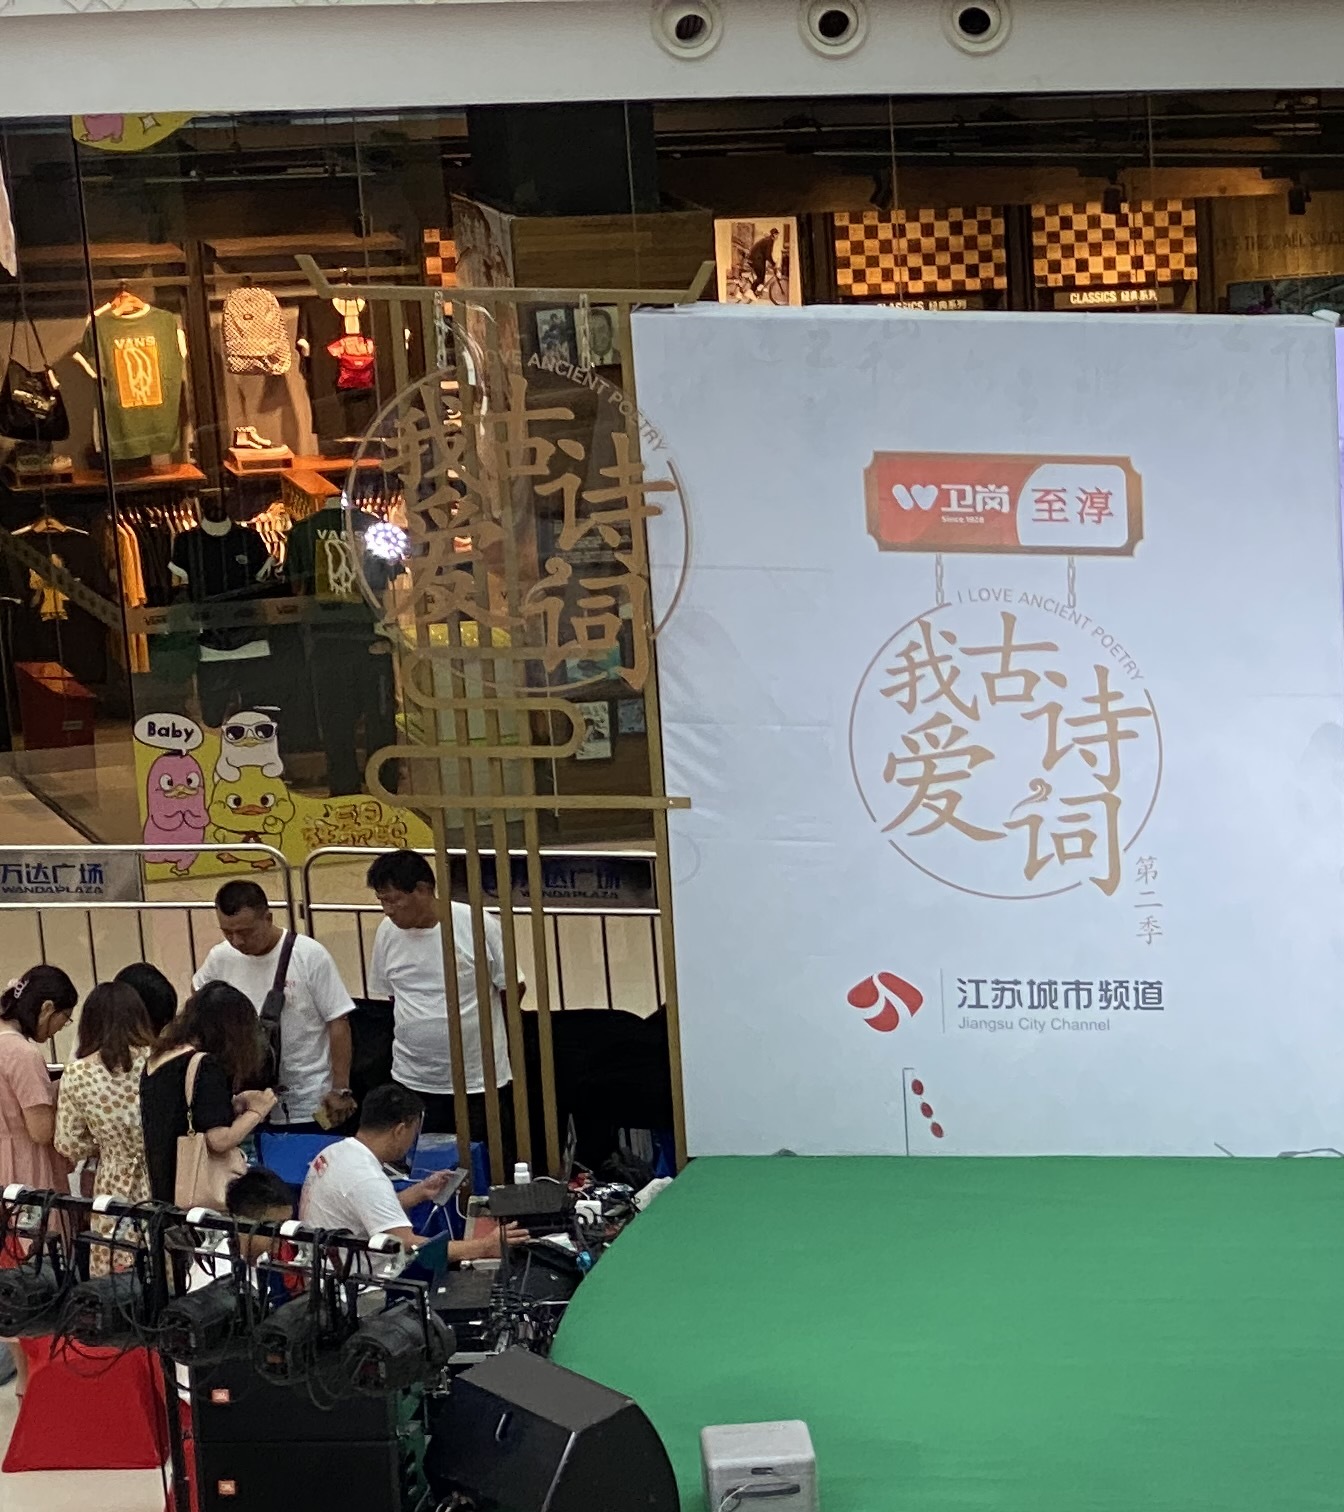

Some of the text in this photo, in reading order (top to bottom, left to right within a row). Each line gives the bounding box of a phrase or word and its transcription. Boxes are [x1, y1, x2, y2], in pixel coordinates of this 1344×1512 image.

[1070, 291, 1116, 304] CLASSICS
[114, 336, 156, 349] VANS
[527, 352, 610, 395] ANCIENT
[941, 484, 1114, 524] 卫岗 至淳
[969, 588, 1013, 603] LOVE
[1017, 591, 1093, 631] ANCIENT
[1091, 625, 1145, 682] POETRY
[147, 722, 195, 743] Baby
[1, 862, 104, 885] 万达广场
[1133, 855, 1164, 945] 第二季
[957, 977, 1165, 1010] 江苏城市频道
[958, 1016, 1111, 1034] Jiangsu City Channel
